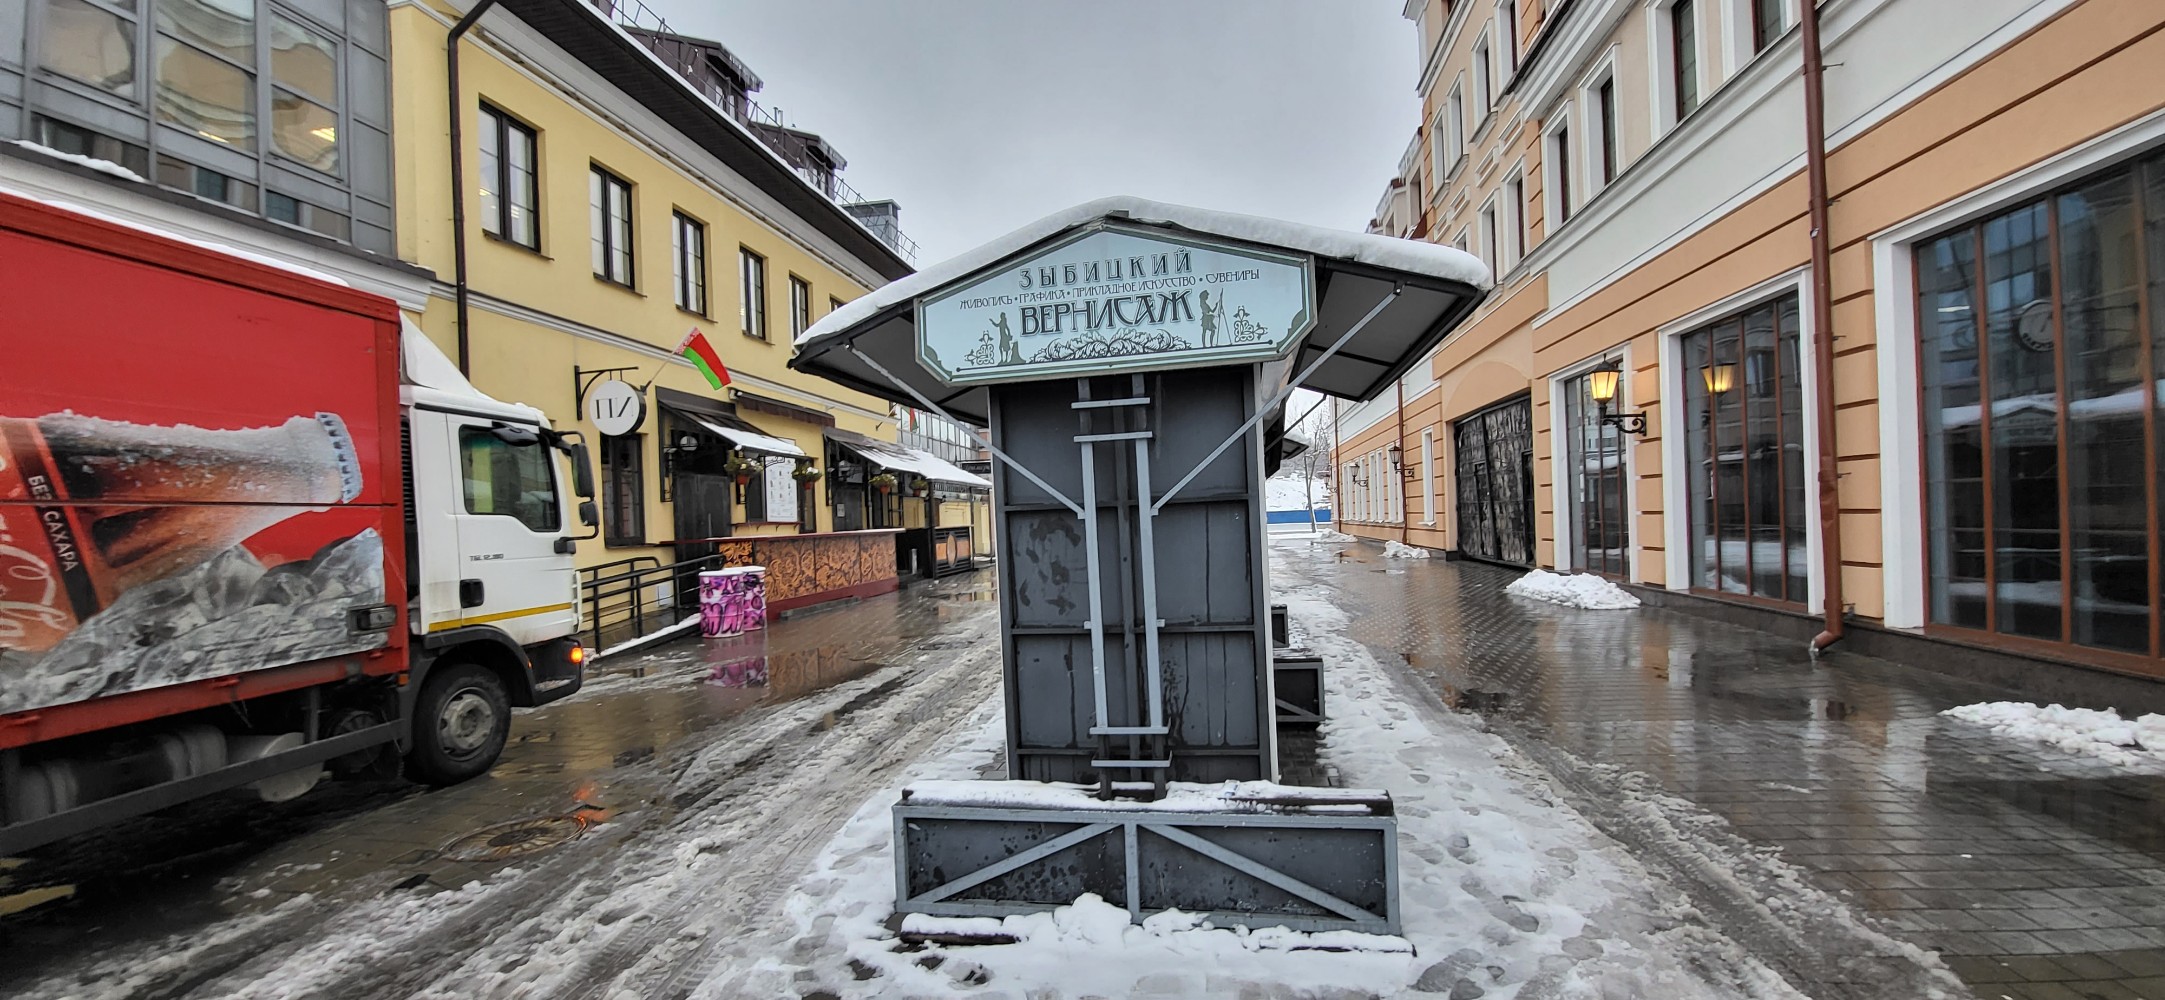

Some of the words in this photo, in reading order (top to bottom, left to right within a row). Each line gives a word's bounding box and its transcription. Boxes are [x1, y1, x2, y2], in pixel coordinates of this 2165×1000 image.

[960, 295, 1013, 310] ЖИВОПИСЬ
[1019, 289, 1066, 304] ГРАФИКА
[1072, 282, 1136, 298] ПРИКЛАДНОЕ
[1138, 275, 1196, 292] ИСКУССТВО
[1205, 269, 1260, 284] СУВЕНИРЫ
[1019, 247, 1191, 289] ЗЫБИЦКИЙ
[1019, 289, 1195, 337] ВЕРНИСАЖ
[43, 510, 79, 572] САХАРА
